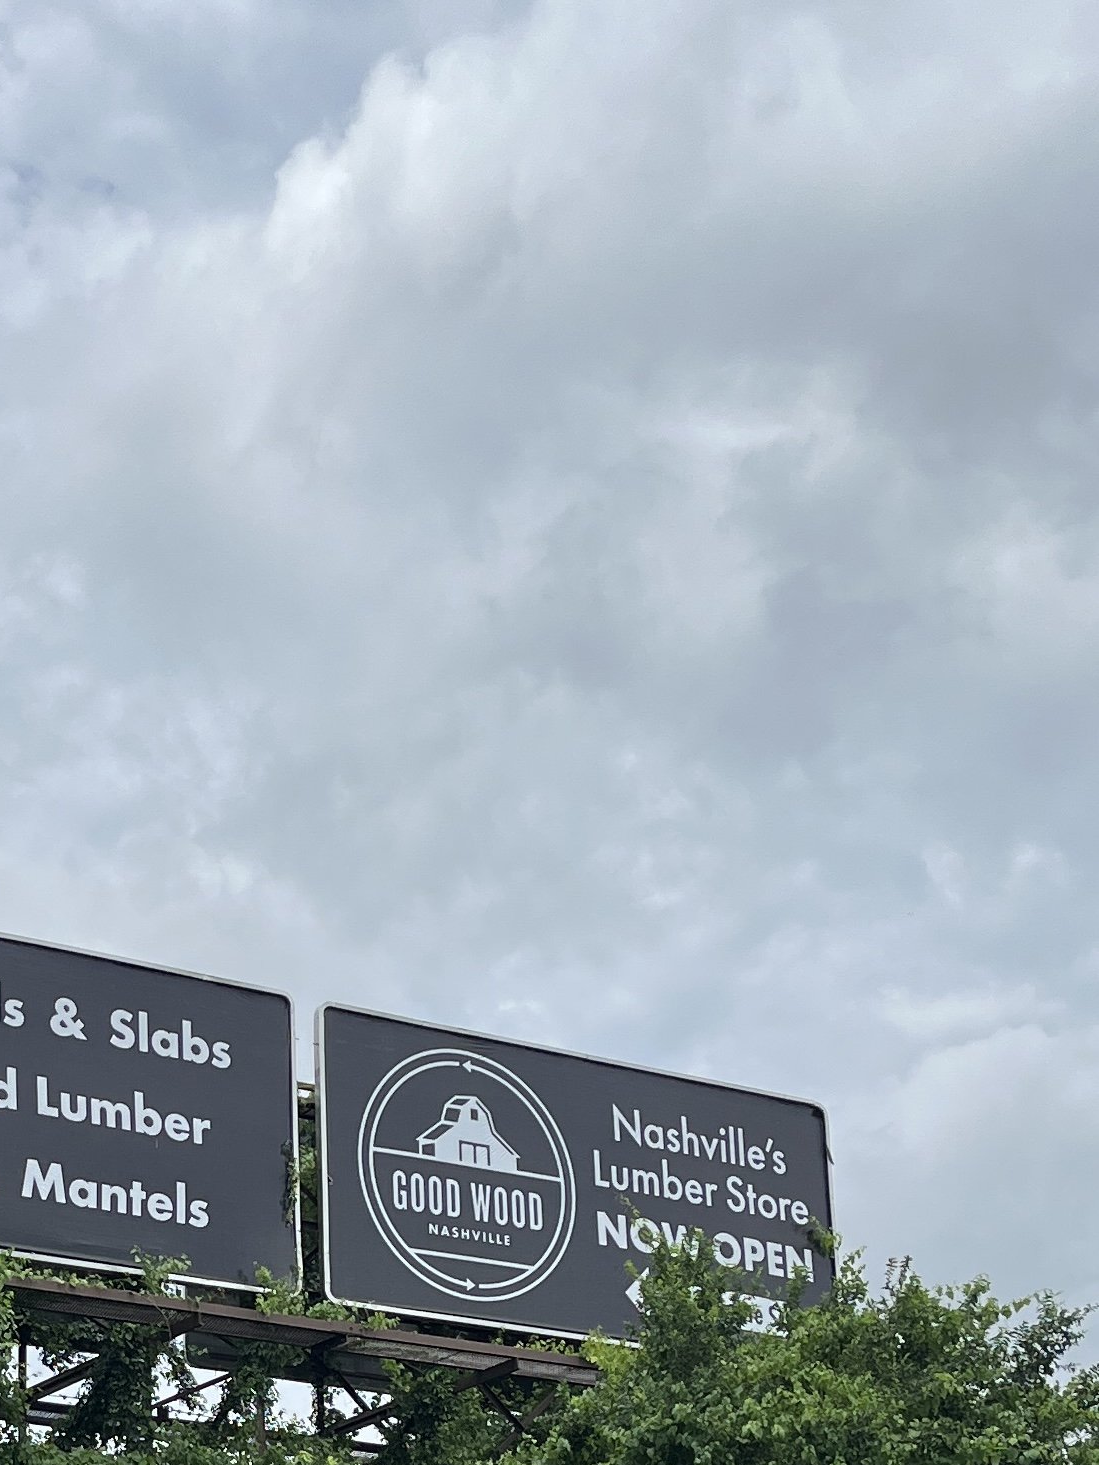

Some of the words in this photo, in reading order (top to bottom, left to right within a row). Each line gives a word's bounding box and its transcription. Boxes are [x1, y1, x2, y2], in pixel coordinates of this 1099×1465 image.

[49, 997, 88, 1041] &
[109, 1009, 232, 1069] Slabs
[36, 1075, 211, 1145] Lumber
[612, 1103, 787, 1175] Nashville's
[21, 1158, 209, 1228] Mantels
[392, 1169, 461, 1218] GOOD
[470, 1182, 543, 1231] WOOD
[593, 1149, 718, 1207] Lumber
[726, 1175, 809, 1225] Store
[428, 1223, 511, 1247] NASHVILLE
[711, 1231, 815, 1283] OPEN
